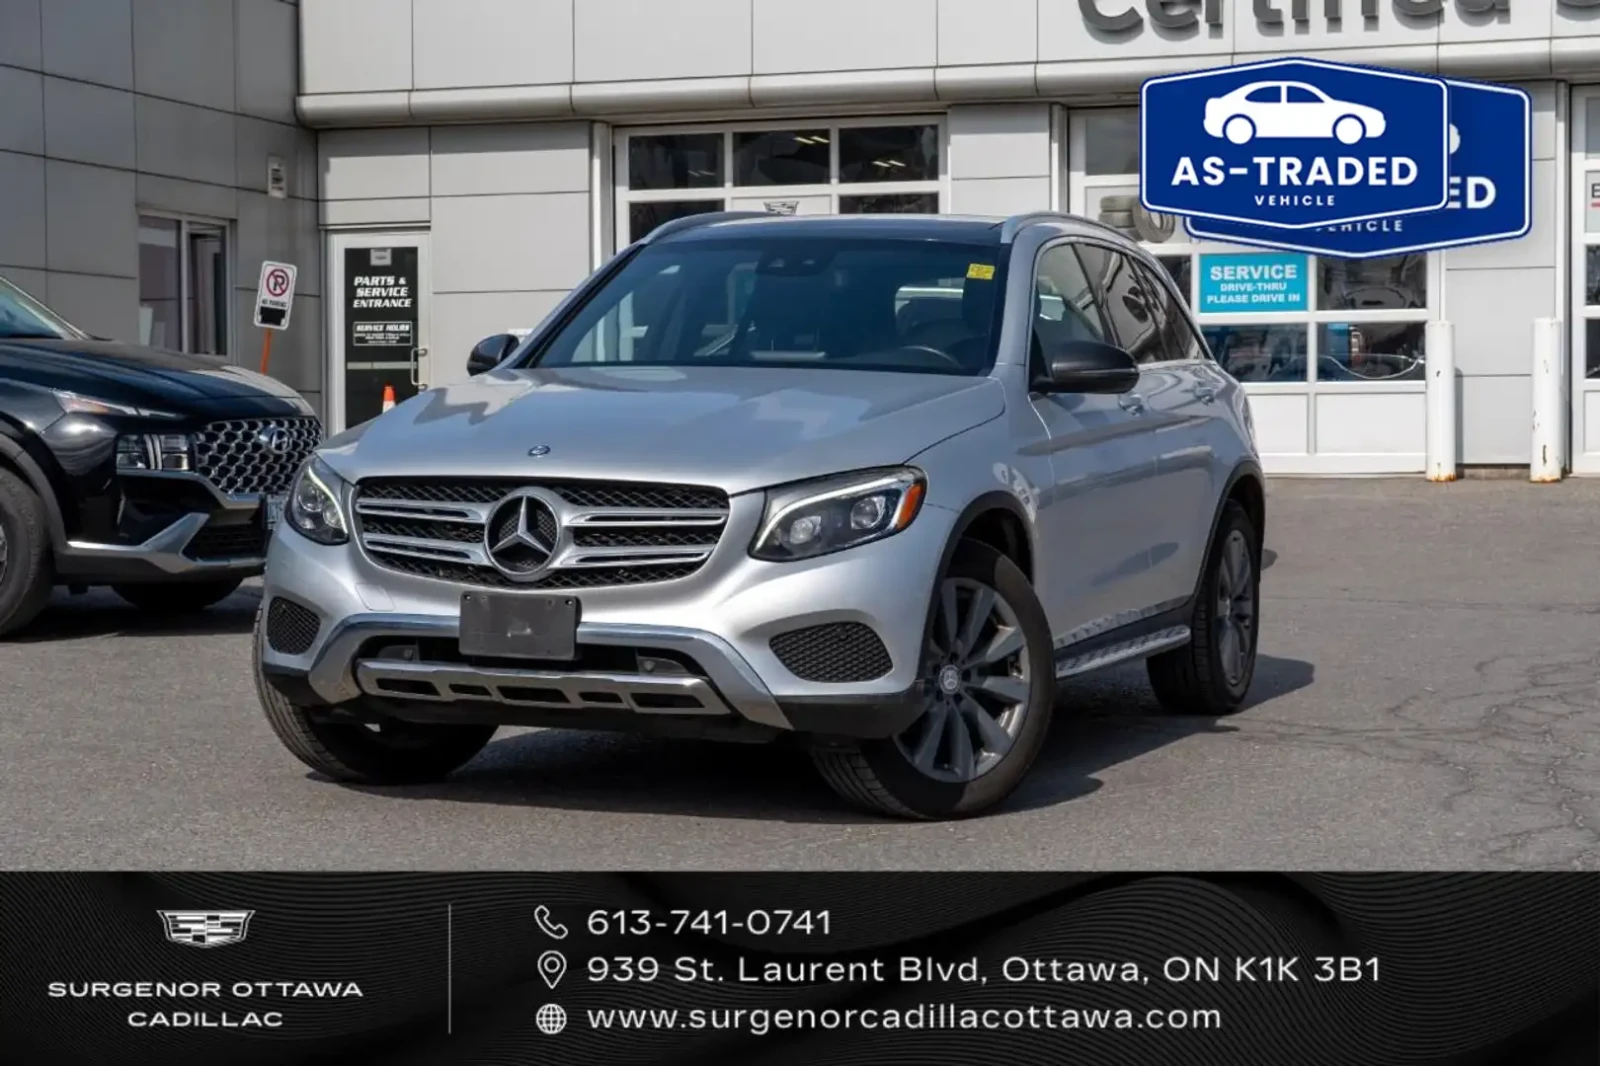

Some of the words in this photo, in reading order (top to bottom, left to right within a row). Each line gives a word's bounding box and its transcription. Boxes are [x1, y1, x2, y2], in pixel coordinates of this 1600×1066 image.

[1210, 264, 1298, 280] SERVICE
[354, 276, 395, 286] PARTS
[398, 277, 407, 285] &
[356, 287, 409, 297] SERVICE
[1220, 282, 1288, 292] DRIVE-THRU
[353, 298, 413, 308] ENTRANCE
[1207, 294, 1249, 304] PLEASE
[1251, 293, 1285, 303] DRIVE
[1288, 293, 1301, 302] IN
